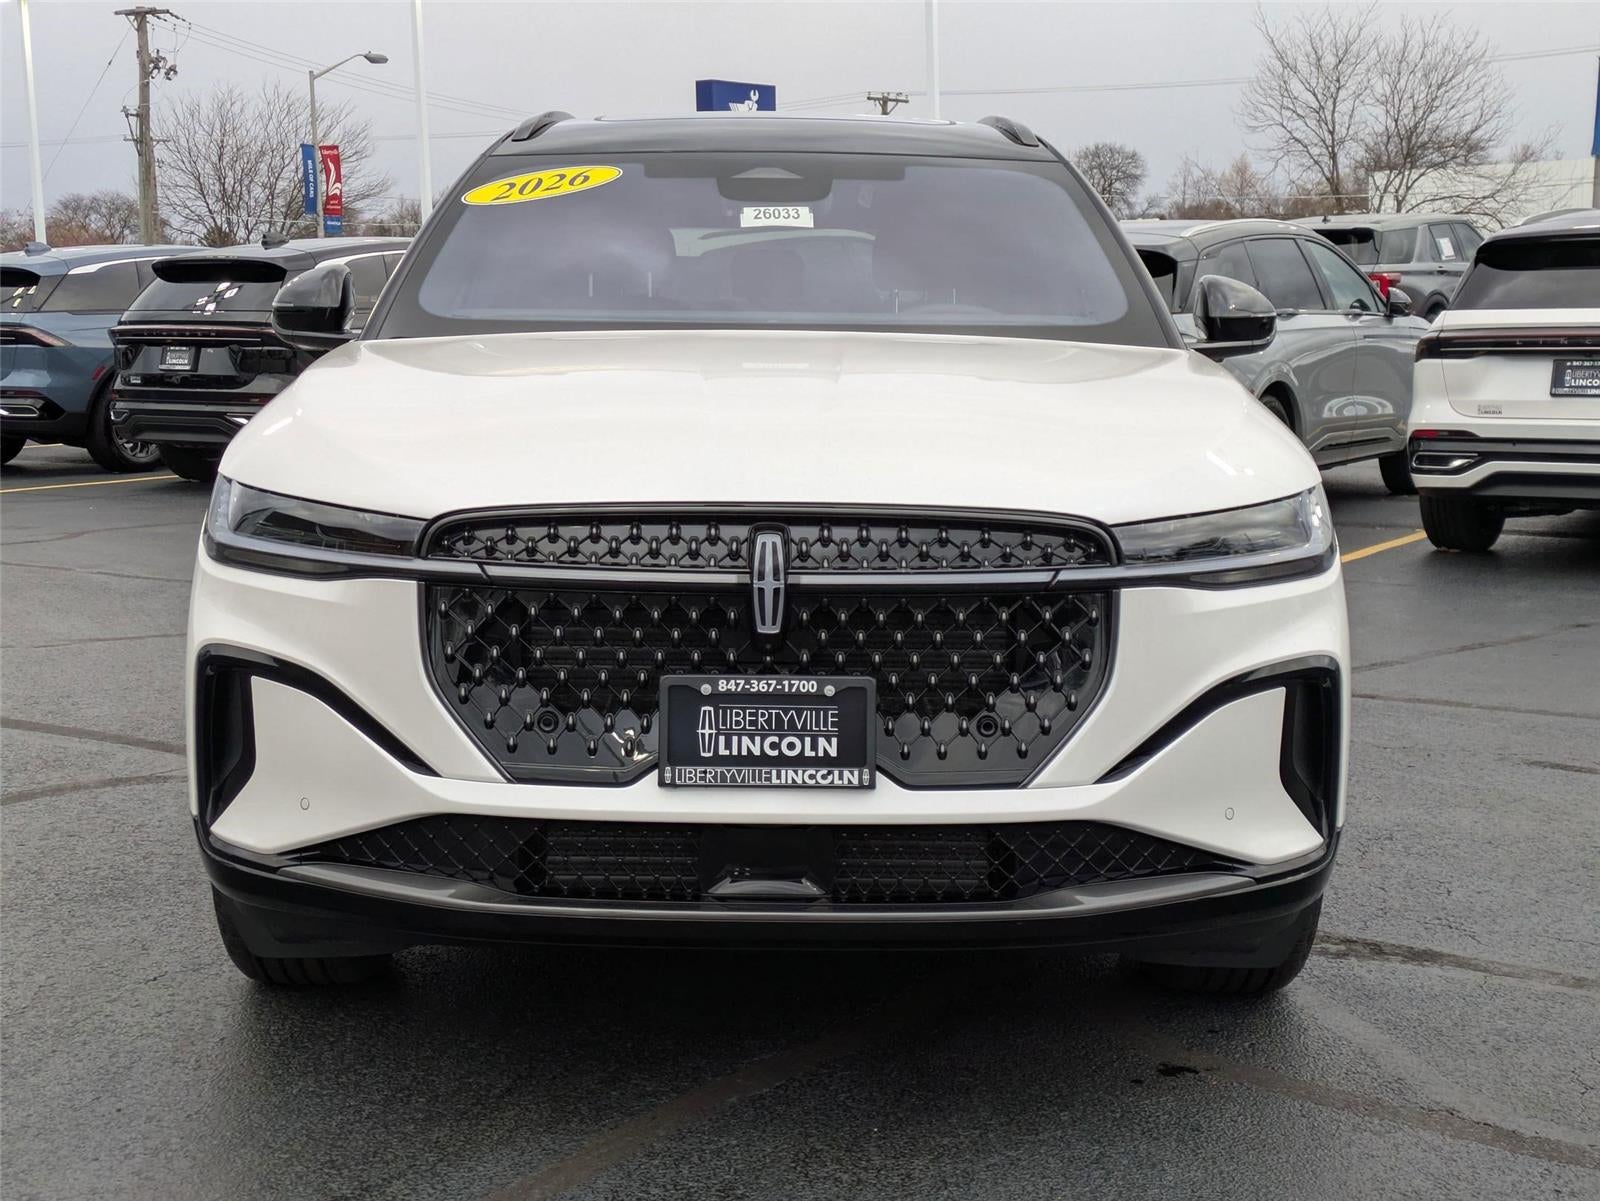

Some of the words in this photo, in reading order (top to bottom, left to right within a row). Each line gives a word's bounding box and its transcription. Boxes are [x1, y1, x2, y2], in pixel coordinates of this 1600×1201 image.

[490, 168, 593, 201] 2026
[753, 208, 800, 219] 26033
[718, 680, 817, 693] 847-367-1700
[719, 709, 839, 731] LIBERTYVILLE
[718, 735, 838, 758] LINCOLN
